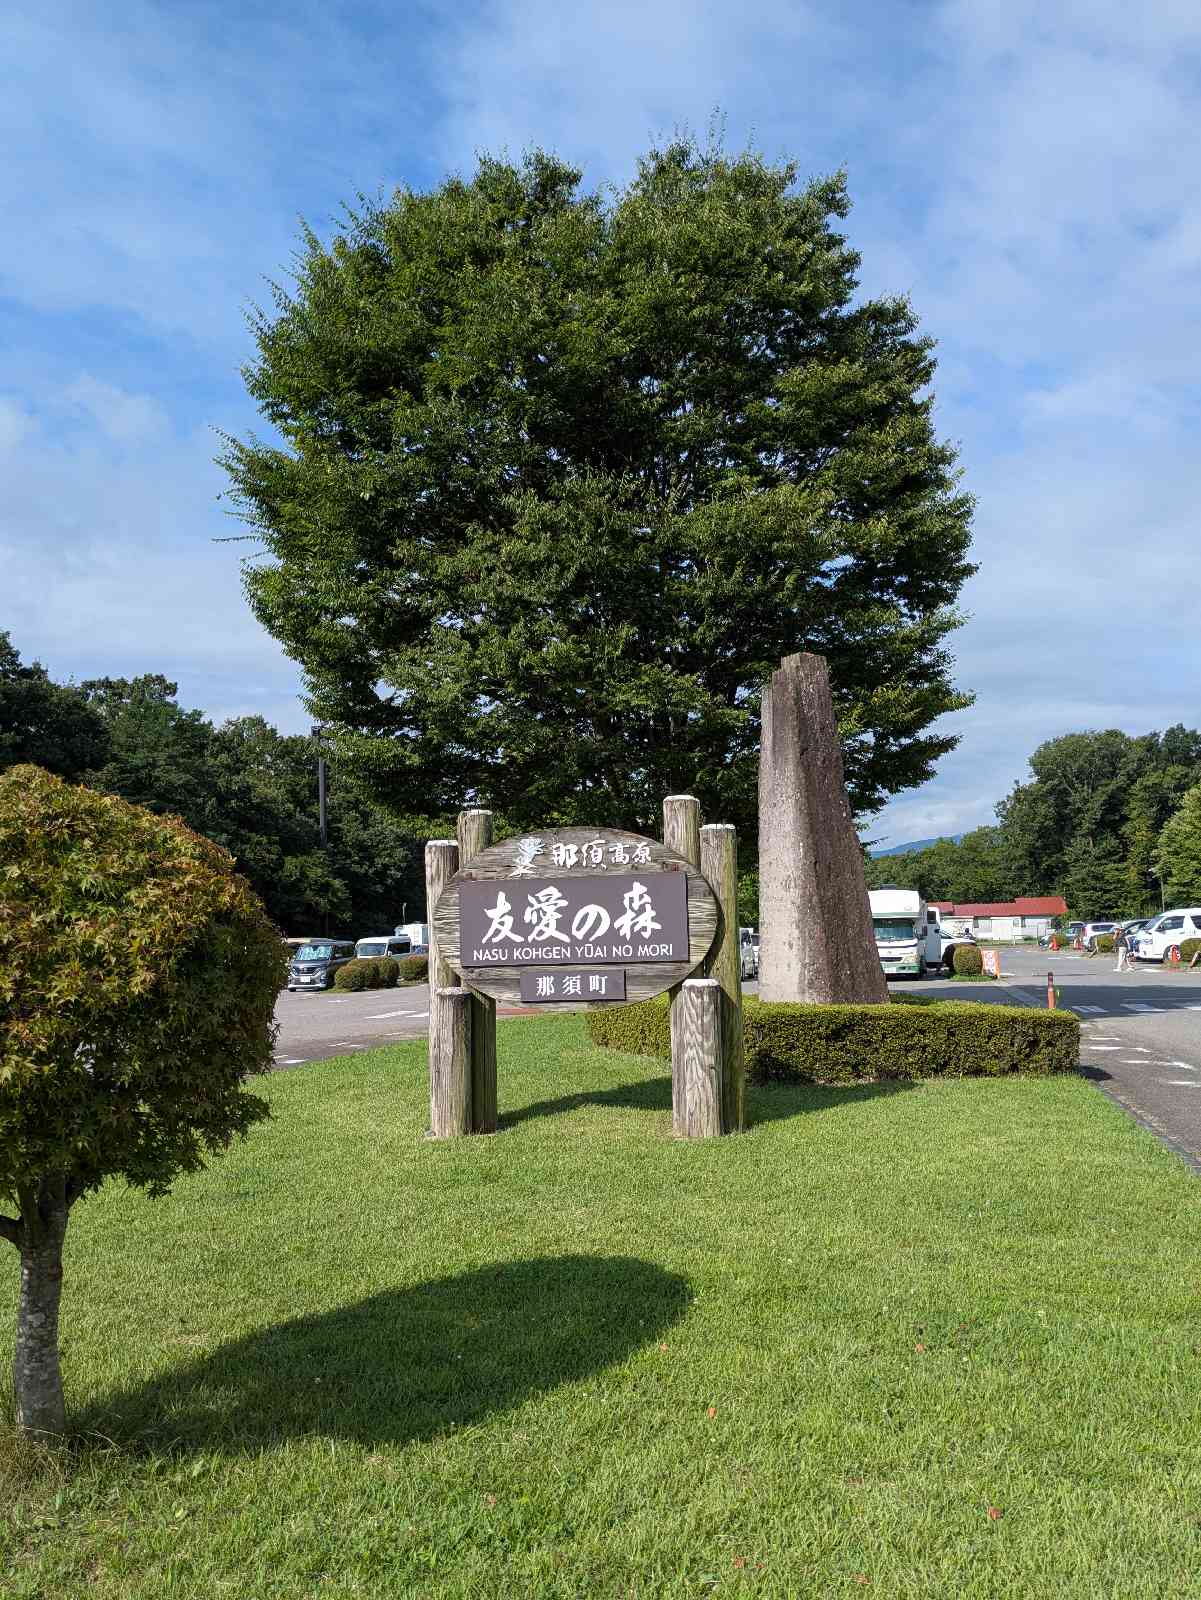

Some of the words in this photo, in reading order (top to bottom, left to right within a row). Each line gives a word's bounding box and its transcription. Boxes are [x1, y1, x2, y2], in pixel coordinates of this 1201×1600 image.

[481, 881, 662, 944] 友愛の森
[473, 948, 508, 961] NASU
[513, 946, 571, 961] KOHGEN
[612, 944, 633, 958] NO
[637, 943, 673, 957] MORI
[535, 974, 609, 997] 那須町
